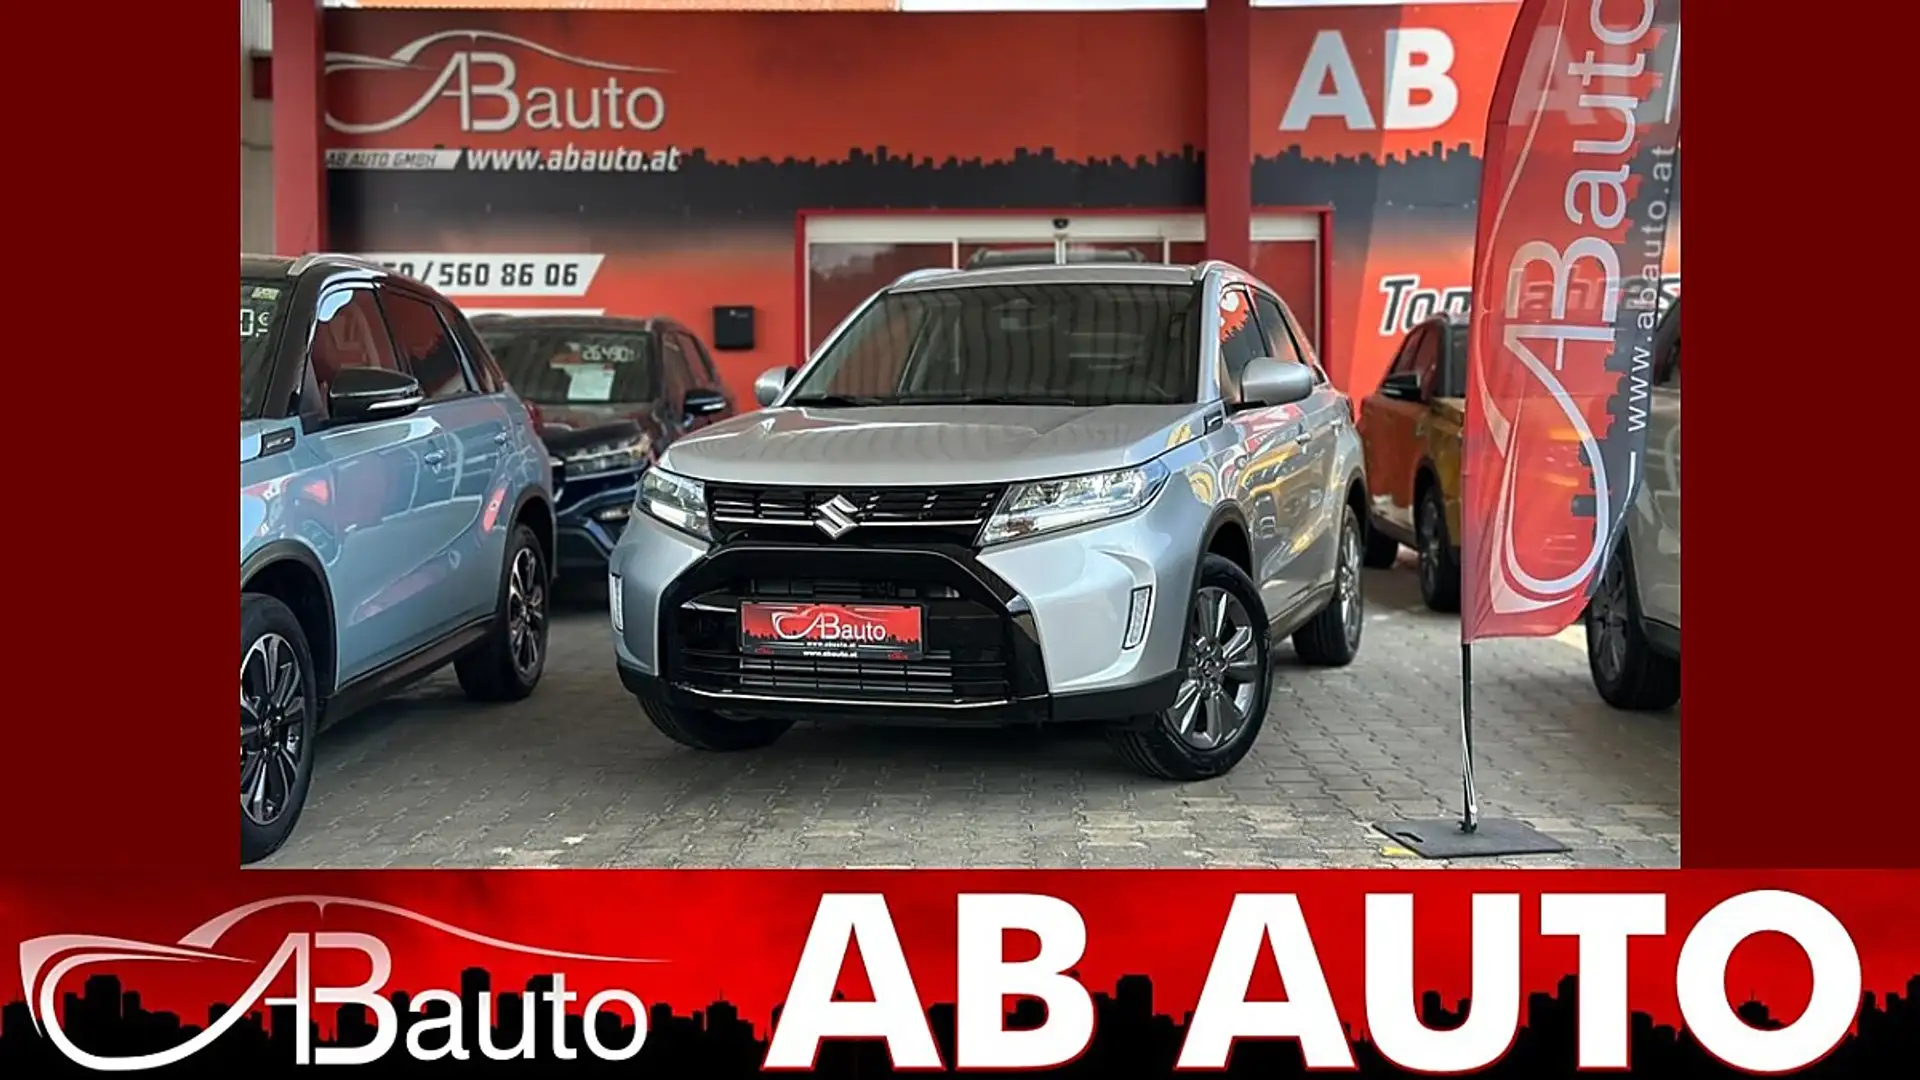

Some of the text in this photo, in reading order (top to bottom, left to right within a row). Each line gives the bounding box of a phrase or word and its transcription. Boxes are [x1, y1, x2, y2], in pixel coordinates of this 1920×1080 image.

[1278, 27, 1459, 131] AB
[350, 151, 389, 167] AUTO
[467, 143, 682, 172] www.abauto.at
[501, 263, 534, 287] 86
[544, 263, 579, 287] 06
[1627, 145, 1676, 433] www.abauto.at
